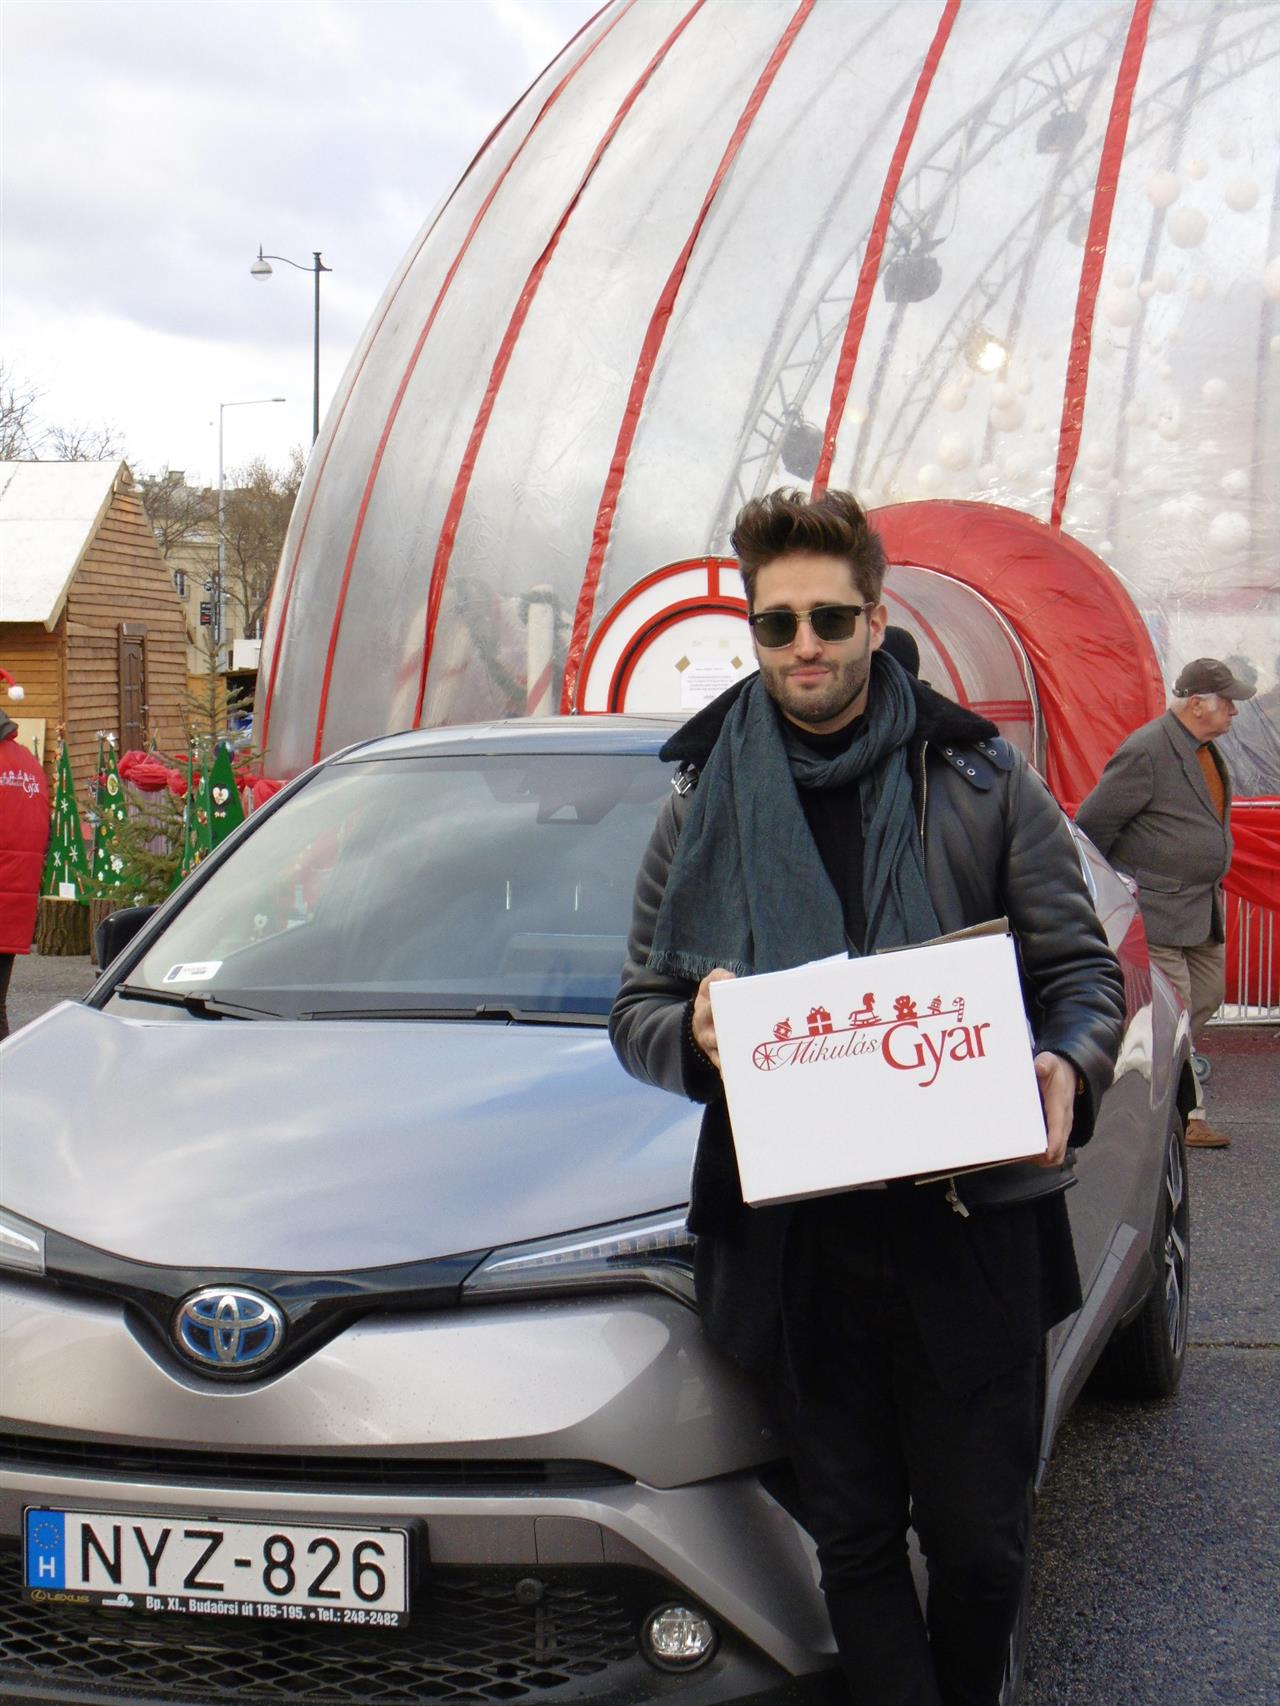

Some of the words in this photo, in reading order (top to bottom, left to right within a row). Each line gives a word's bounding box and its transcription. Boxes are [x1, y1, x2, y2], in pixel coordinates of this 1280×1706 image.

[776, 1030, 880, 1068] Mikulás
[38, 1556, 56, 1579] H
[80, 1522, 387, 1602] NYZ-826
[47, 1591, 90, 1604] LEXUS
[145, 1595, 165, 1611] Bp.
[188, 1598, 239, 1616] Budaörsi
[241, 1601, 254, 1617] út
[256, 1603, 307, 1620] 185-195.
[317, 1607, 341, 1622] Tel.:
[343, 1609, 399, 1627] 248-2482
